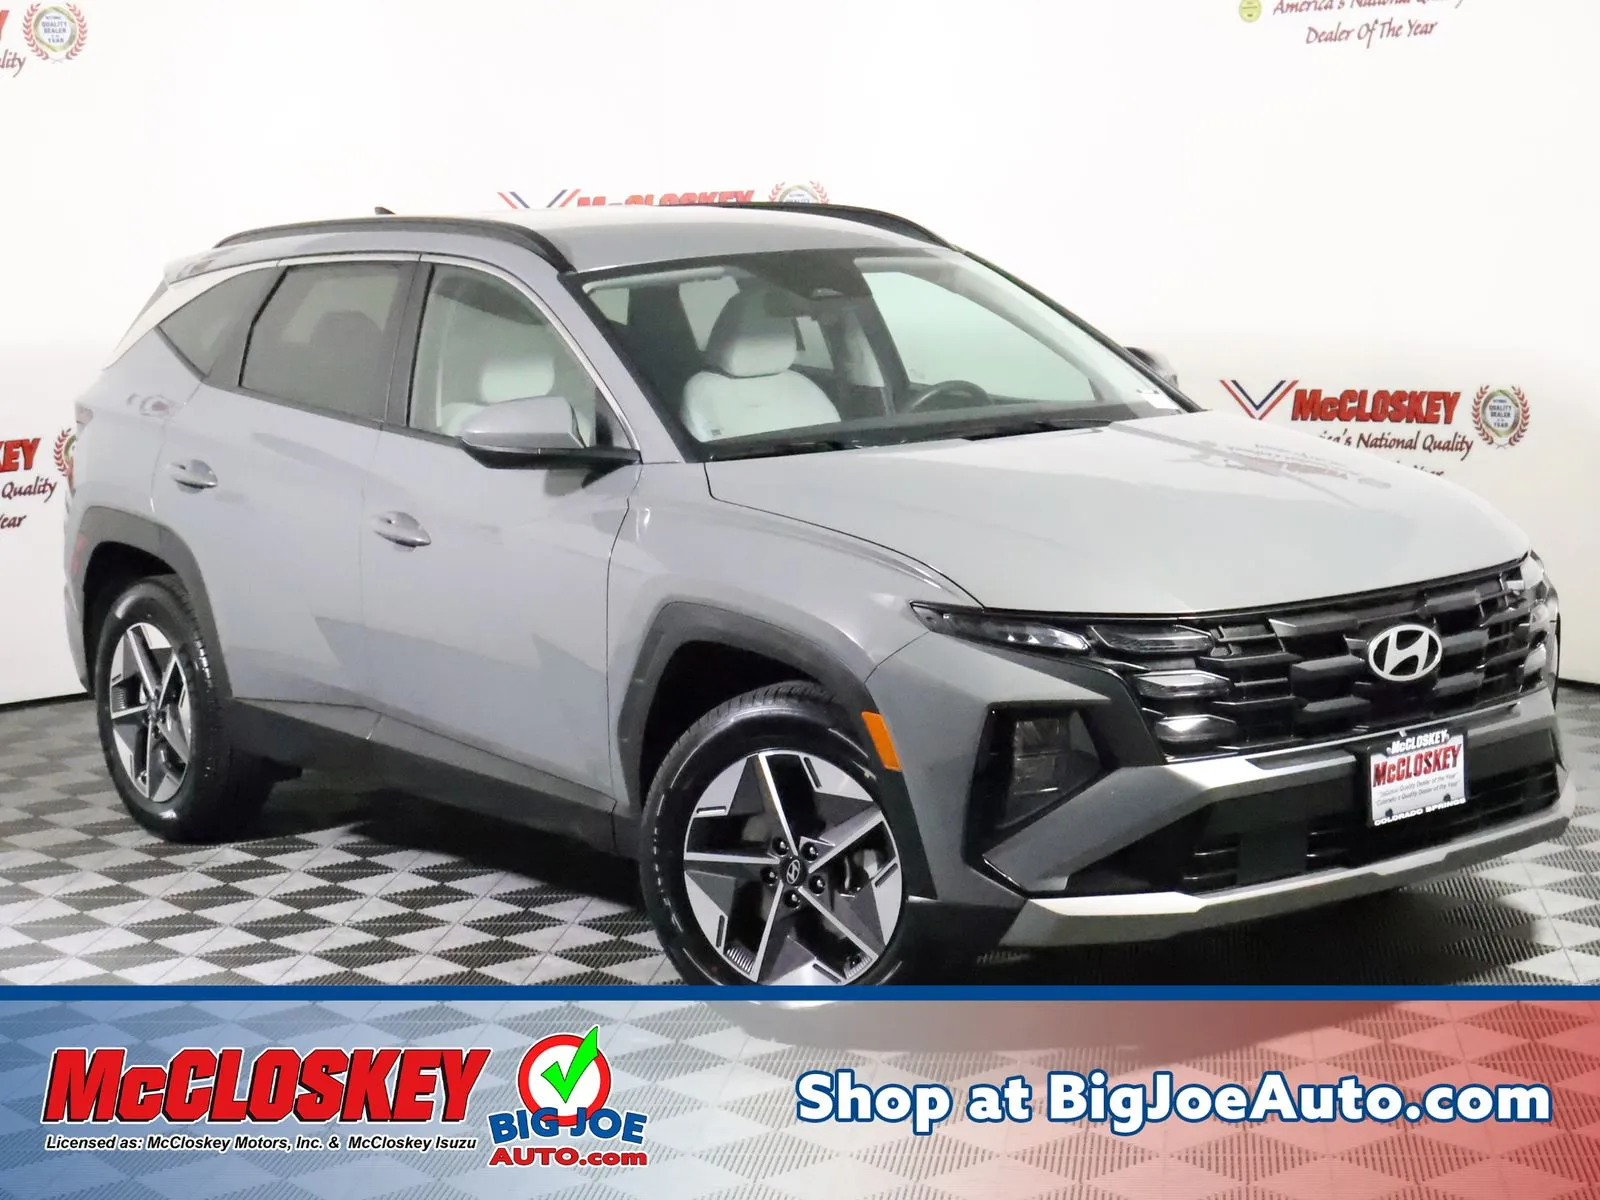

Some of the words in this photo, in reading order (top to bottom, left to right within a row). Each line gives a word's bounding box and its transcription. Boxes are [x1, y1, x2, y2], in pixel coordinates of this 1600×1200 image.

[1305, 21, 1354, 44] Dealer
[1357, 19, 1379, 49] Of
[1379, 17, 1404, 39] The
[1407, 19, 1438, 38] Year
[1291, 389, 1461, 424] McCLOSKEY
[1356, 430, 1420, 450] National
[1422, 432, 1474, 462] Quality
[1, 476, 57, 503] Quality
[1391, 729, 1448, 754] McCLOSKEY
[1372, 744, 1462, 787] McCLOSKEY
[1374, 808, 1423, 826] COLORADO
[1425, 798, 1466, 812] SPRINGS
